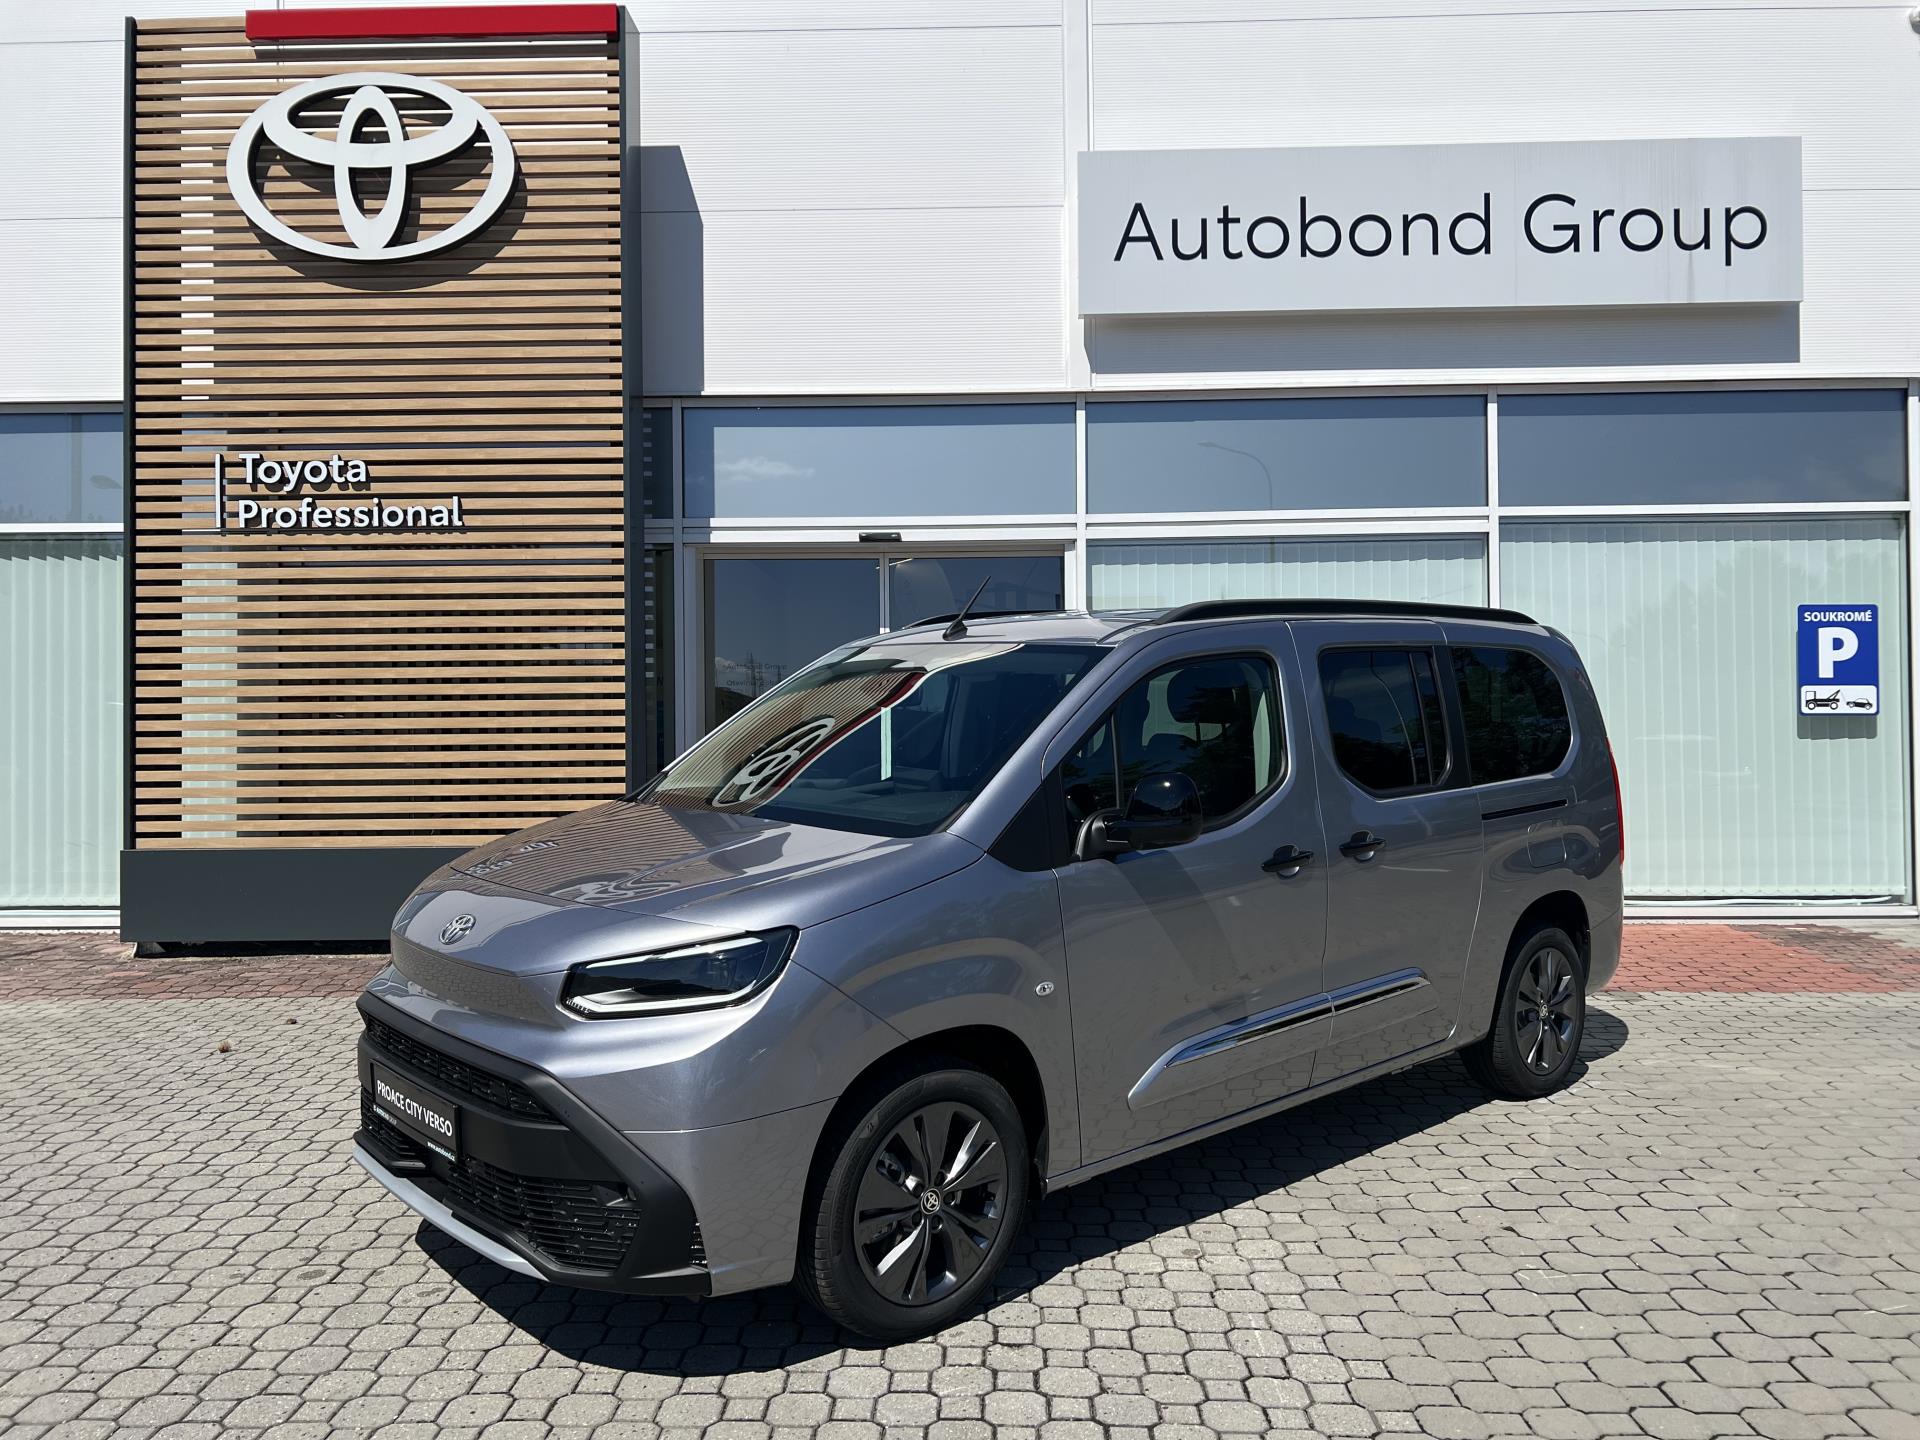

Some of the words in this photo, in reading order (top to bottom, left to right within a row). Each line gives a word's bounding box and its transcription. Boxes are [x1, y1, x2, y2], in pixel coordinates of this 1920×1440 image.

[1114, 192, 1492, 262] Autobond
[1523, 193, 1768, 266] Group
[238, 453, 367, 492] Toyota
[238, 495, 463, 528] Professional
[1804, 609, 1873, 622] SOUKROMÉ
[1818, 626, 1859, 679] P
[377, 1079, 405, 1111] PROACE
[405, 1098, 423, 1121] CITY
[423, 1107, 453, 1137] VERSO
